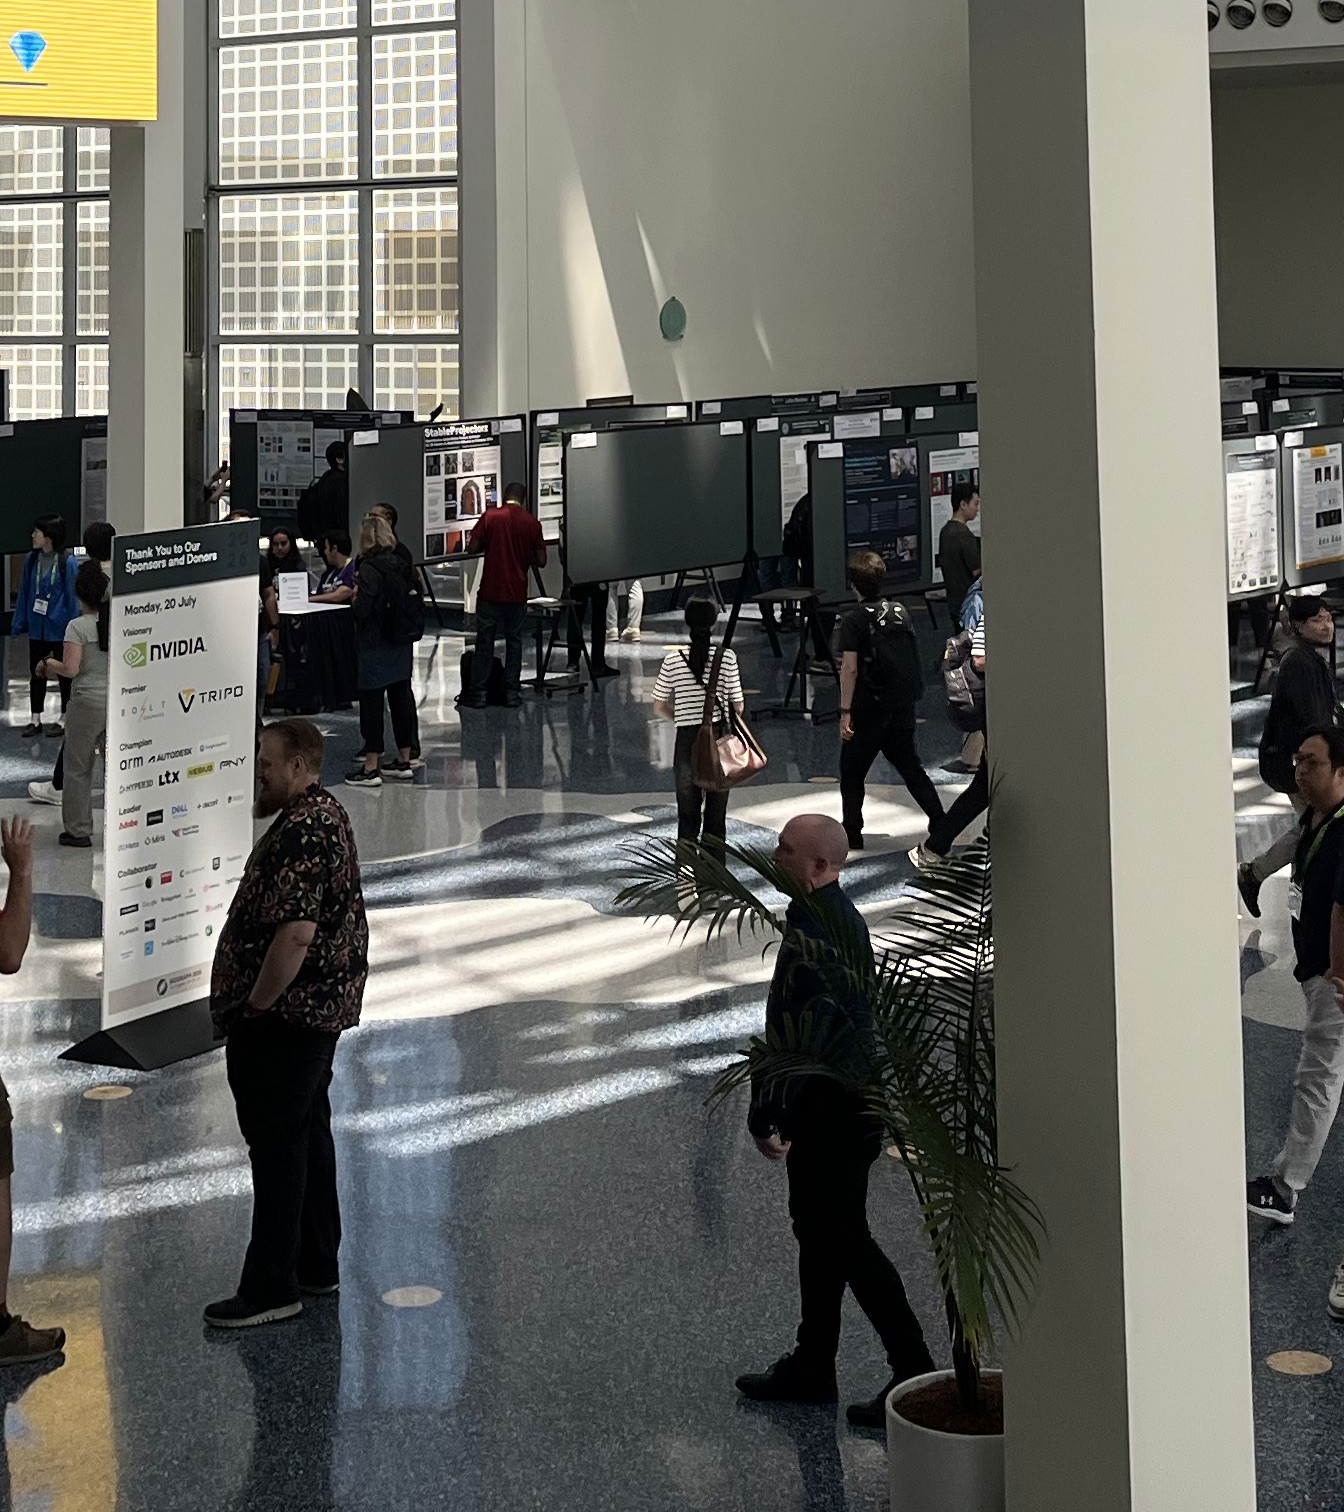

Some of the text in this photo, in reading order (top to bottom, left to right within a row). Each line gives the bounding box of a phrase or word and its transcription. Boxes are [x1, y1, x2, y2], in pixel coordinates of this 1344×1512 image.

[125, 541, 201, 561] Thank You to Our
[125, 552, 218, 575] Sponsors and Donors
[164, 598, 176, 610] 20
[178, 595, 197, 609] July
[122, 627, 153, 638] Visionary
[198, 685, 244, 704] TRIPO
[119, 739, 153, 751] Champion
[119, 755, 144, 771] arm
[119, 804, 142, 816] Leader
